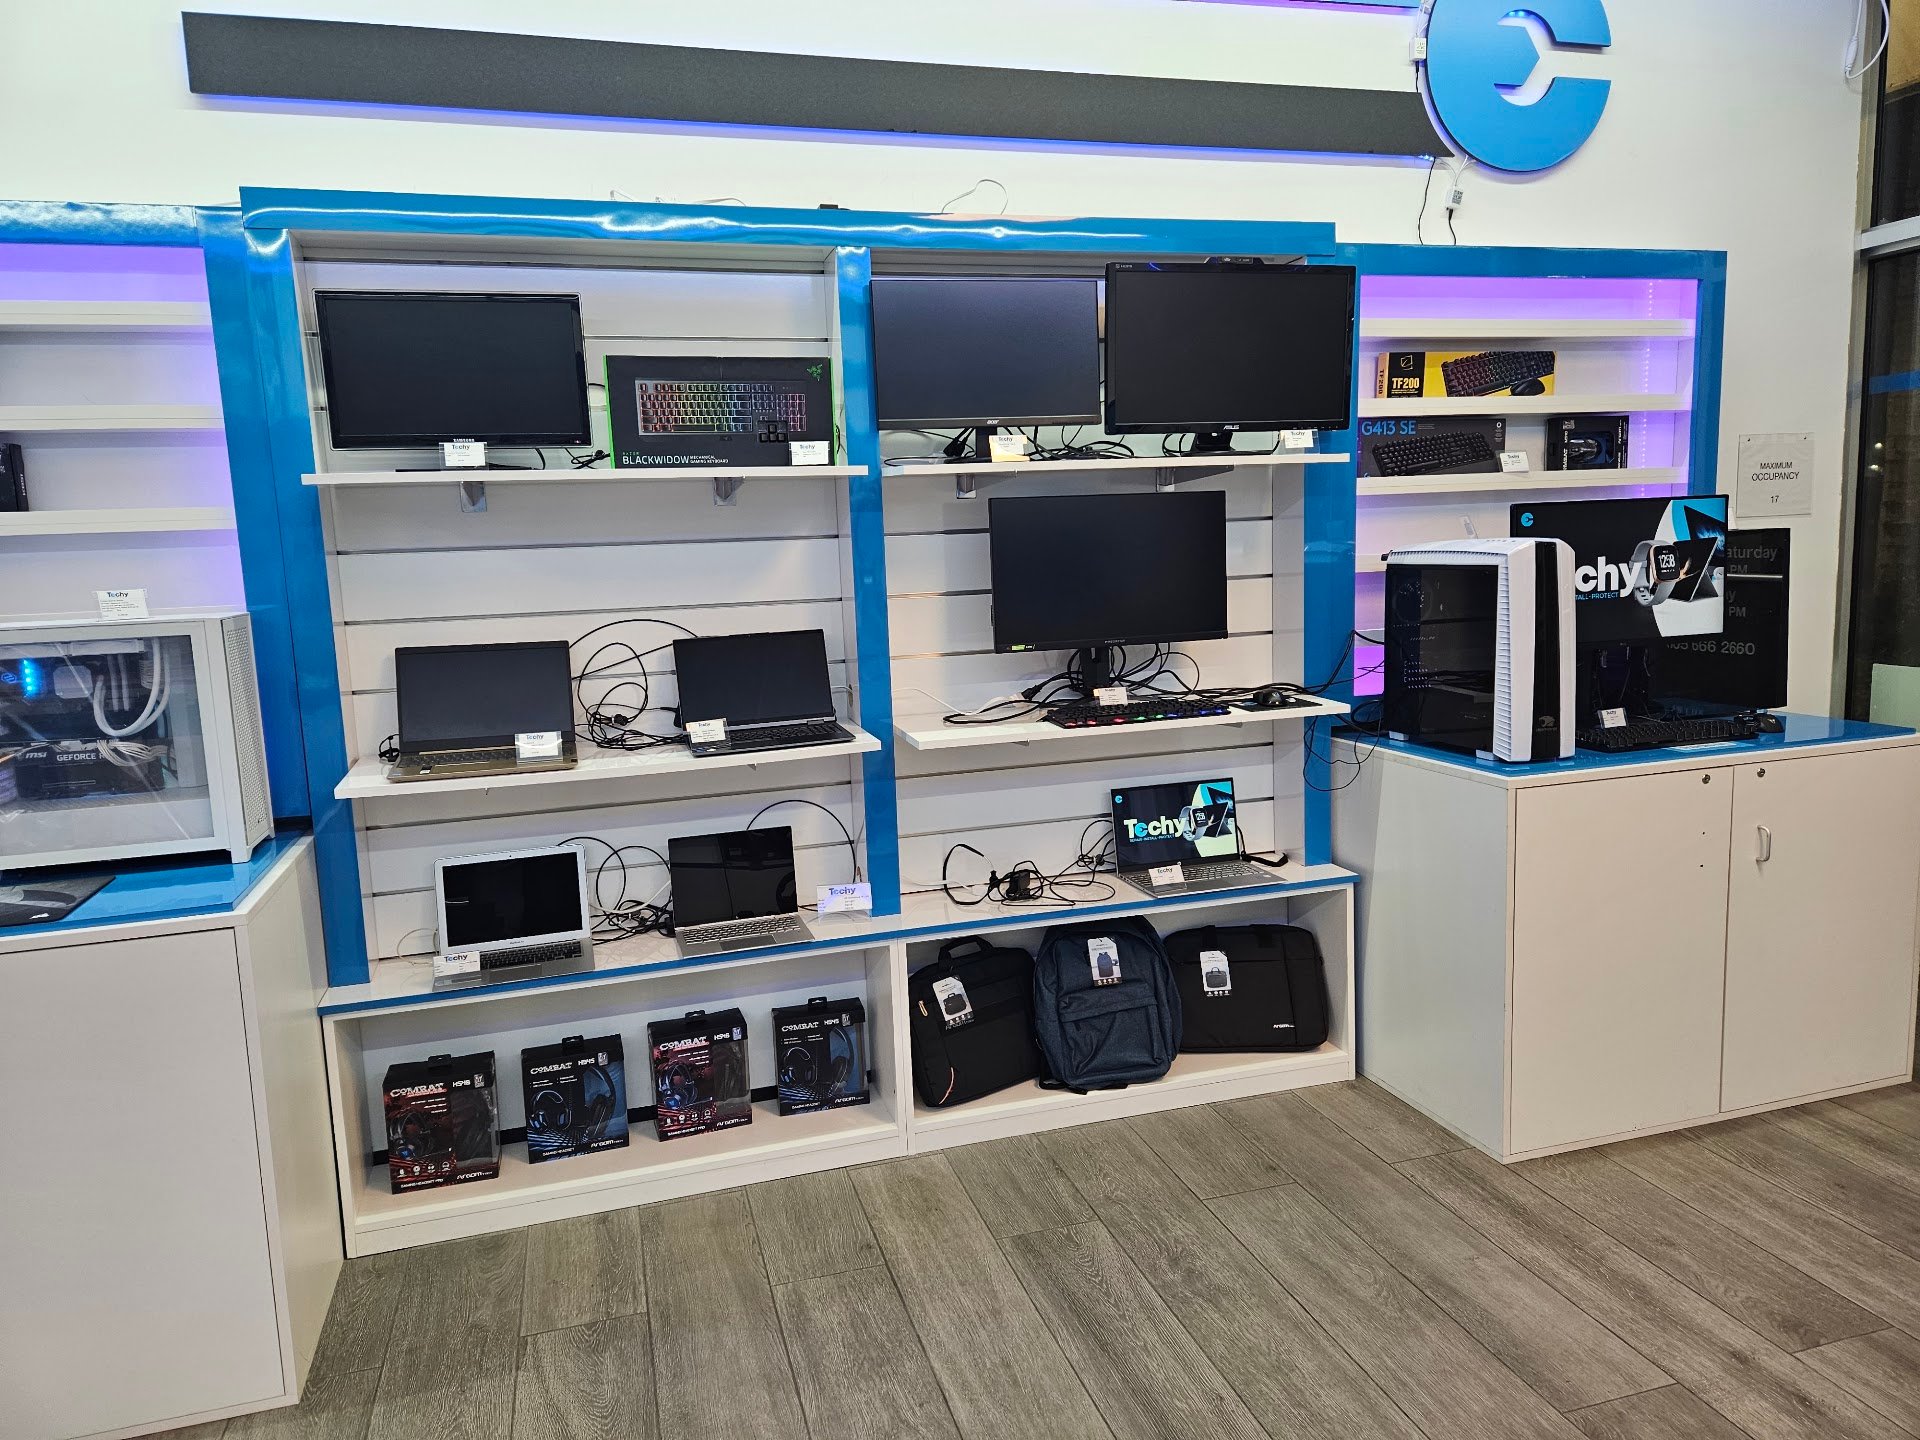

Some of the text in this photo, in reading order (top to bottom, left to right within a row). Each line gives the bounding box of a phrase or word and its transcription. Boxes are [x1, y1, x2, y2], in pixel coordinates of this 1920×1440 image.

[1392, 377, 1420, 389] TF200
[1361, 420, 1396, 436] G413
[1400, 420, 1416, 435] SE
[622, 456, 689, 465] BLACKWIDOW
[1760, 462, 1793, 470] MAXIMUM
[1752, 472, 1800, 482] OCCUPANCY
[1770, 495, 1780, 504] 17
[1726, 545, 1778, 562] aturday
[1728, 606, 1746, 617] PM
[1720, 641, 1756, 656] 2660
[56, 752, 96, 762] GEFORCE
[1124, 816, 1186, 838] Techy
[829, 886, 856, 896] Techy
[444, 954, 468, 963] Techy
[782, 1022, 818, 1032] COMBAT
[660, 1036, 706, 1050] COMBAT
[530, 1062, 572, 1074] COMBAT
[390, 1082, 444, 1097] COMBAT
